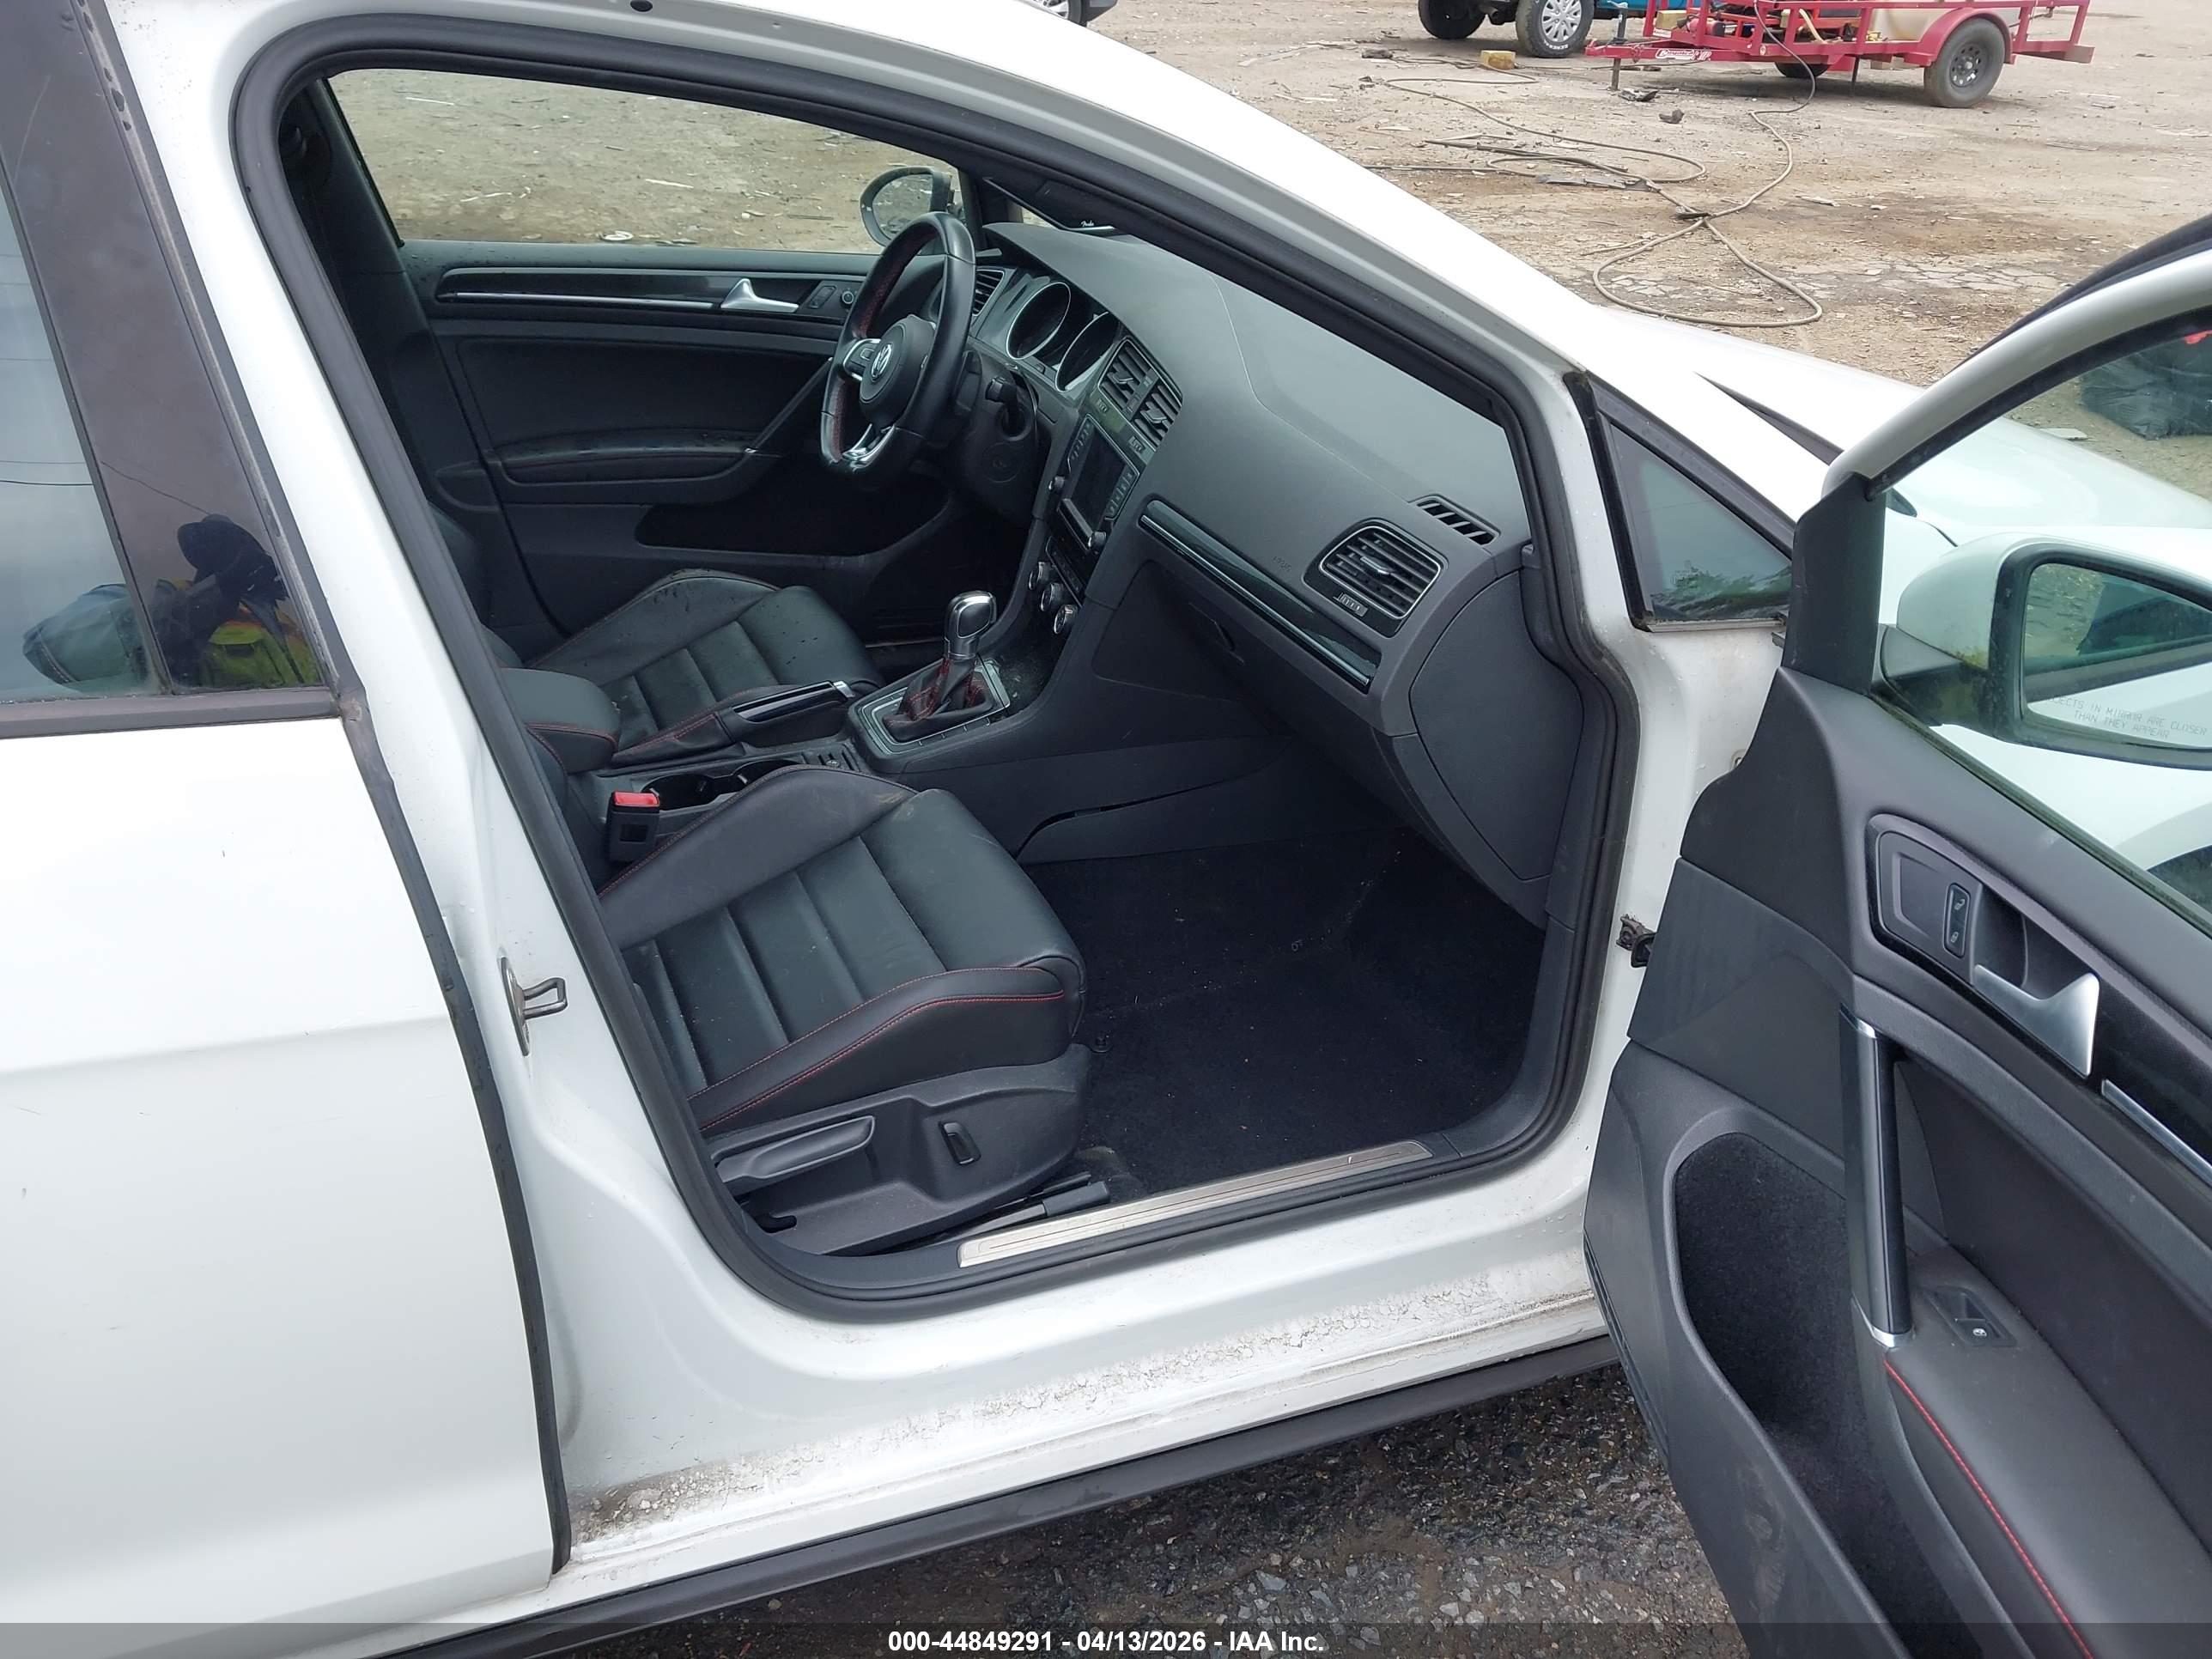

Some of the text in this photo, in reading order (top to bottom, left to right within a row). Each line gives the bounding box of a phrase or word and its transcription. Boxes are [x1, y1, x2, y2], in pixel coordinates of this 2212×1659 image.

[1543, 39, 1569, 50] GENERAL
[2074, 710, 2171, 738] THAN THEY APPEAR
[2089, 704, 2102, 714] IN
[2106, 707, 2142, 722] MIRROR
[2146, 716, 2165, 727] ARE
[2170, 720, 2208, 735] CLOSER
